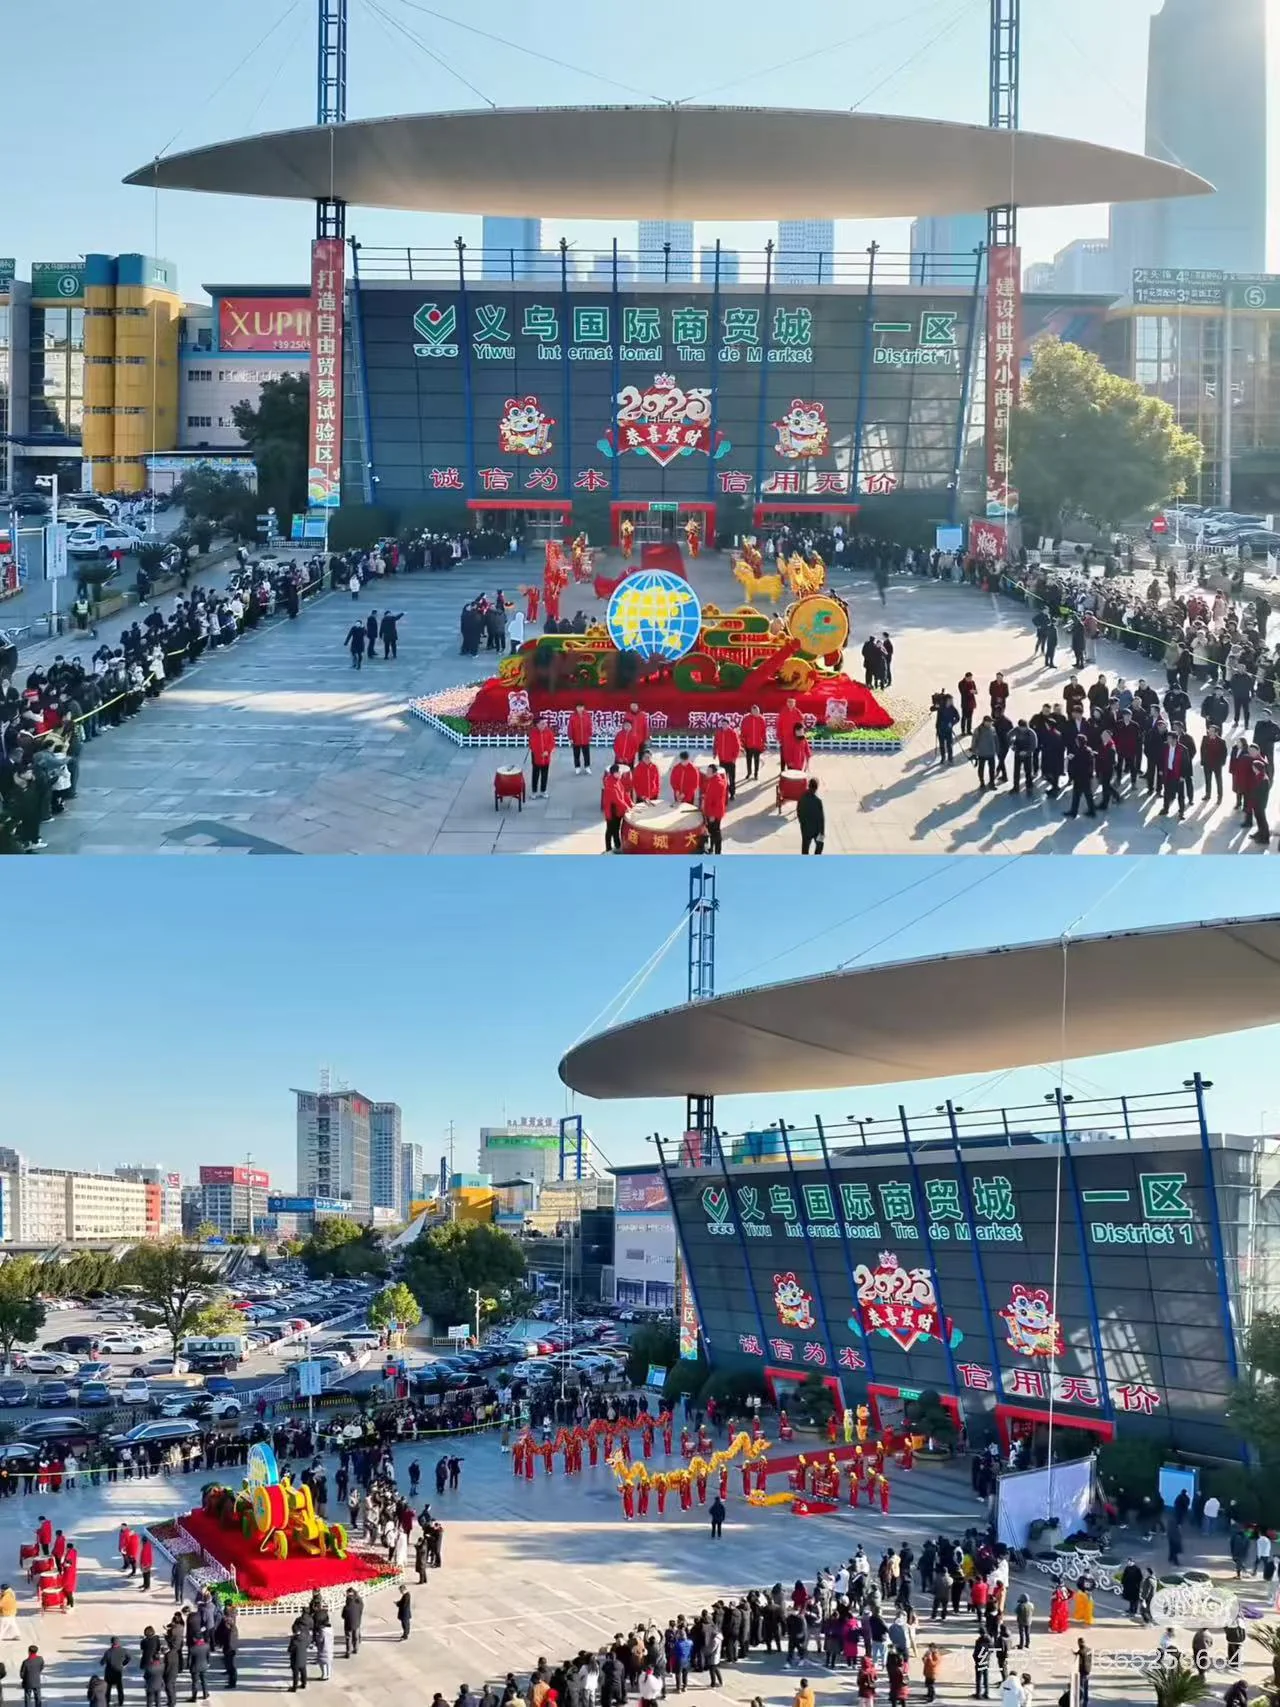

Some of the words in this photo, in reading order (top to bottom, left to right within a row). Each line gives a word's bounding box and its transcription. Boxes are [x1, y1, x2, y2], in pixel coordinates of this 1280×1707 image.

[473, 304, 812, 345] 义乌国际商贸城
[873, 311, 957, 345] 一区
[473, 344, 516, 360] Yiwu
[873, 348, 938, 364] District
[944, 349, 952, 365] 1
[315, 270, 336, 465] 打造自由贸易试验区
[993, 277, 1015, 472] 建设世界小商品都
[626, 424, 703, 446] 恭喜发财
[429, 467, 608, 491] 诚信为本
[718, 471, 897, 495] 信用无价
[737, 1176, 1015, 1221] 义乌国际商贸城
[1082, 1172, 1192, 1218] 一区
[742, 1222, 773, 1237] Yiwu
[1091, 1222, 1175, 1244] District
[1180, 1223, 1193, 1245] 1
[868, 1306, 934, 1333] 恭喜发财
[739, 1334, 866, 1369] 诚信为本
[957, 1363, 1159, 1415] 信用无价
